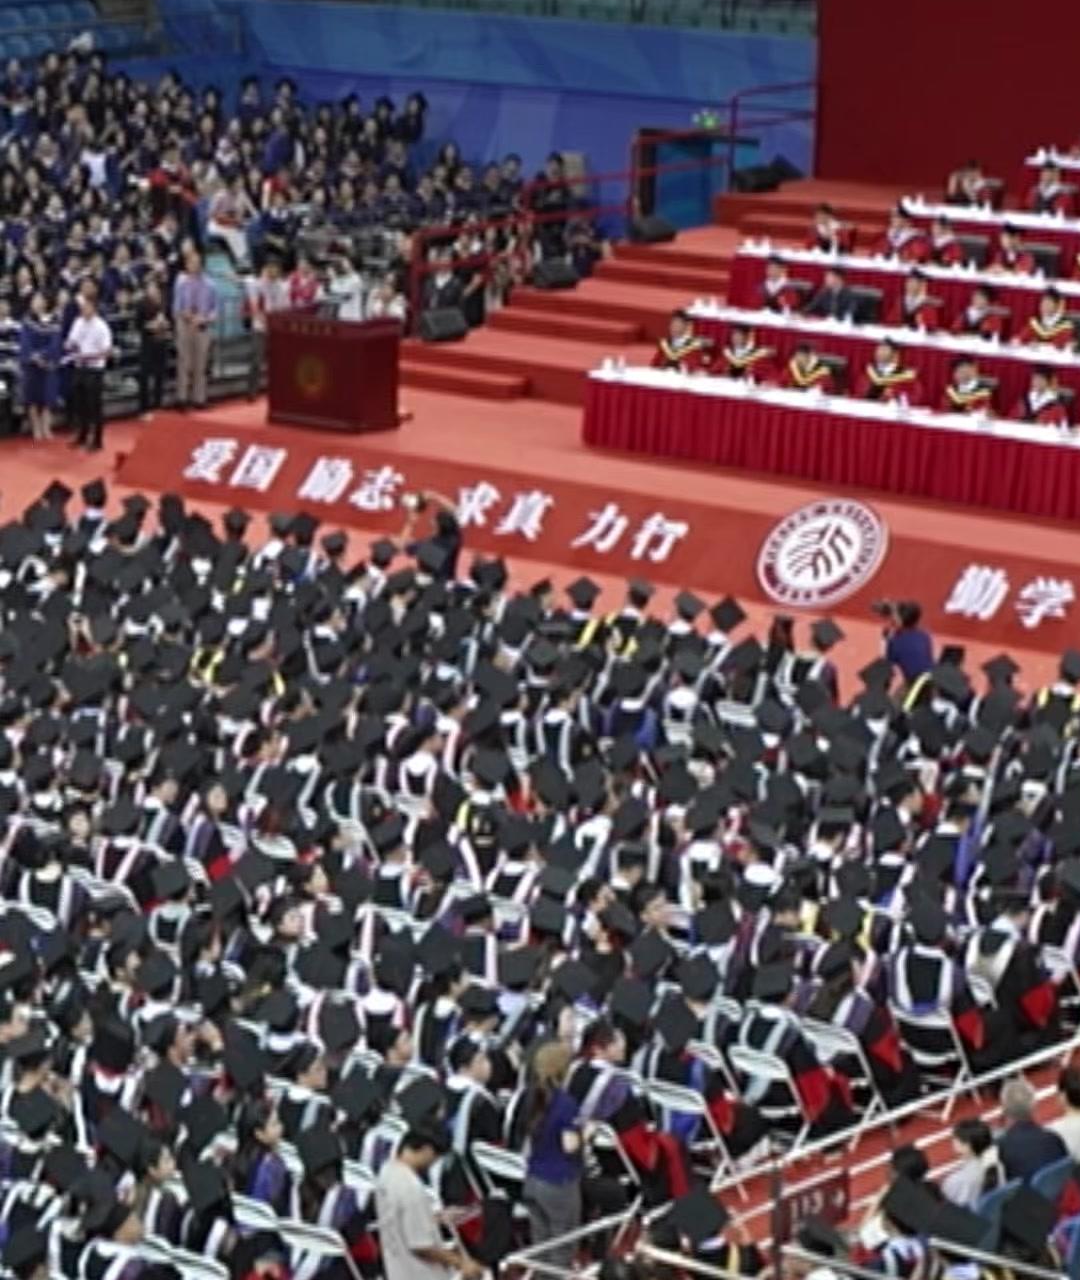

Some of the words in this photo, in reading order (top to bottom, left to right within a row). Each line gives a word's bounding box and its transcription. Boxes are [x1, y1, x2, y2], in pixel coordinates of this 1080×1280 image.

[183, 438, 287, 492] 爱国
[297, 455, 403, 512] 励志
[456, 480, 555, 542] 求真
[570, 502, 690, 563] 力行
[944, 564, 1076, 629] 勤学
